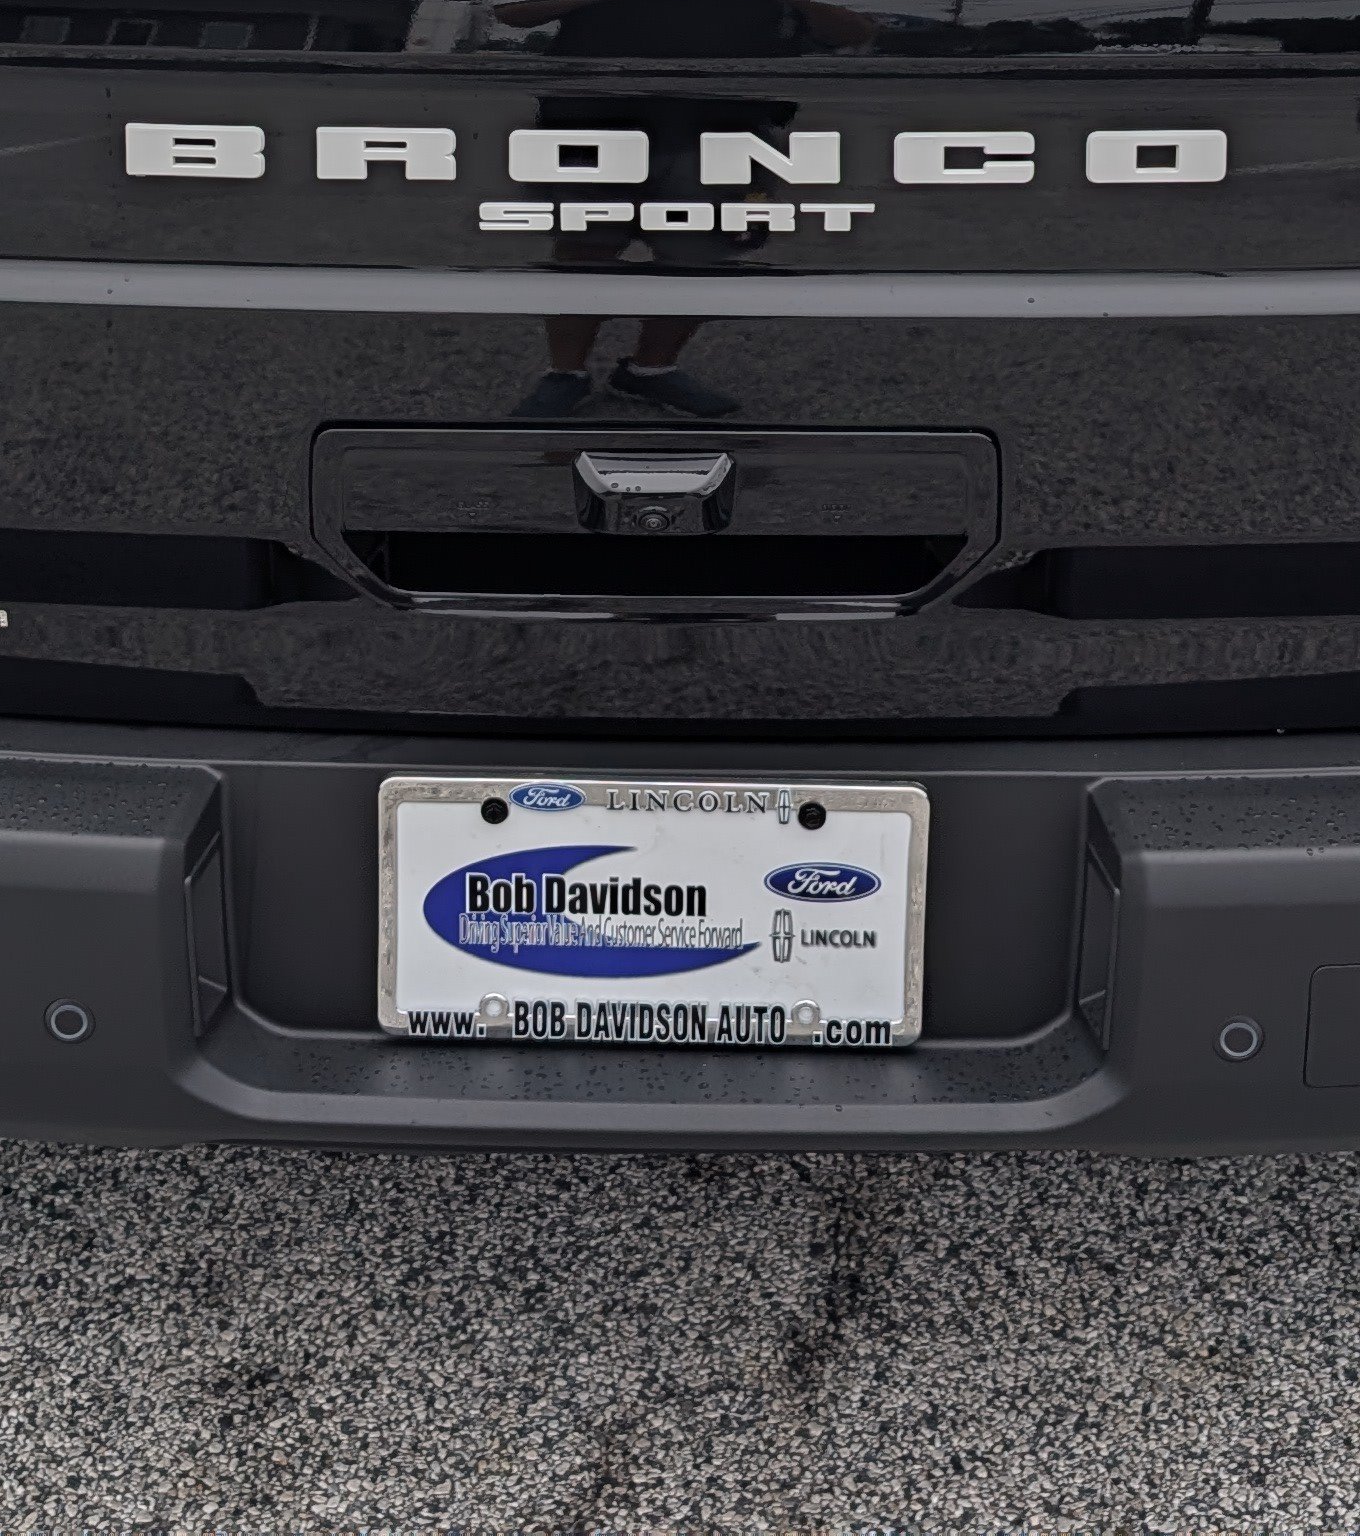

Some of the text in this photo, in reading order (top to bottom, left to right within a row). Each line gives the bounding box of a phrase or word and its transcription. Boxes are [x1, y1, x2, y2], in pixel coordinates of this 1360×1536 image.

[125, 123, 1228, 184] BRONCO
[478, 202, 876, 232] SPORT
[521, 785, 769, 814] Ford LINCOLN
[466, 872, 707, 917] Bob Davidson
[787, 866, 856, 897] Ford
[459, 913, 743, 953] Driving Superior Value And Customer Service Forward
[800, 929, 876, 948] LINCOLN
[408, 1002, 892, 1045] www. BOB DAVIDSON AUTO .com
